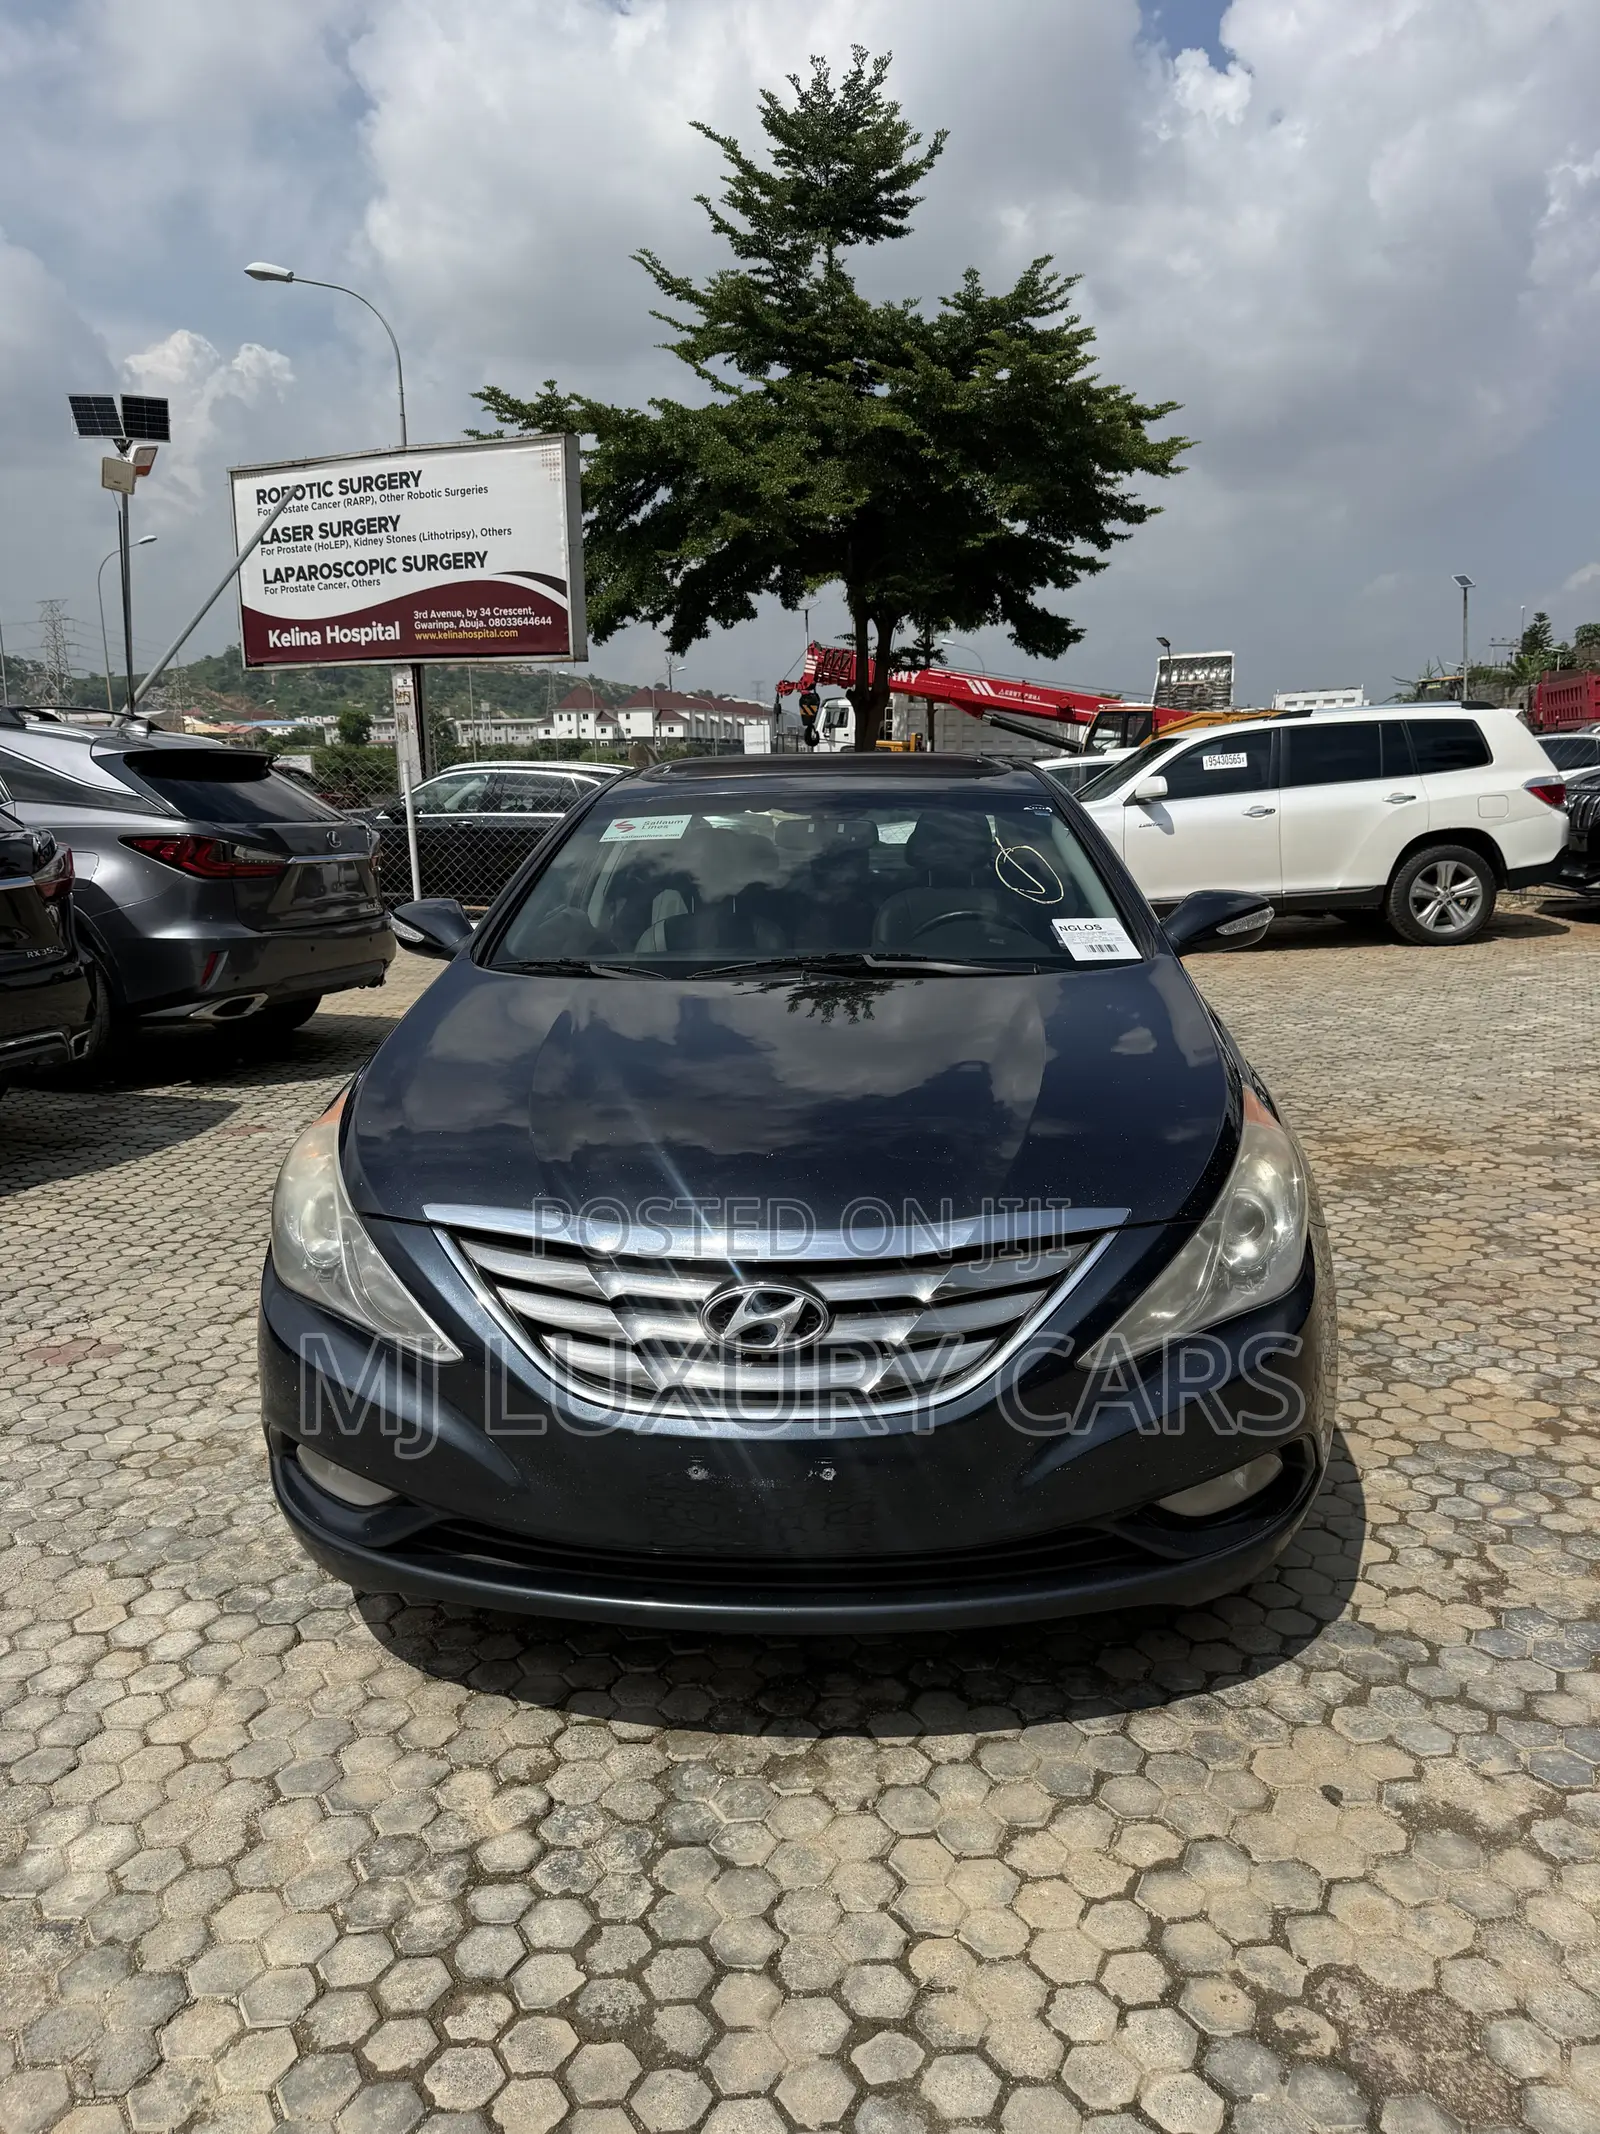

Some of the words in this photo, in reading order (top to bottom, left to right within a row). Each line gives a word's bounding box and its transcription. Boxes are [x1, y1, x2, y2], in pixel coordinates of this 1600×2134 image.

[338, 470, 422, 496] SURGERY
[257, 507, 272, 516] For
[274, 503, 309, 514] ostate
[311, 500, 341, 511] Cancer
[343, 495, 377, 508] (RARP),
[379, 492, 405, 503] Other
[407, 487, 442, 500] Robotic
[444, 484, 489, 498] Surgeries
[318, 514, 401, 539] SURGERY
[260, 546, 275, 556] For
[277, 544, 312, 555] Prostate
[314, 540, 352, 552] (HoLEP),
[353, 536, 384, 547] Kidney
[386, 534, 417, 544] Stones
[419, 528, 478, 543] (Lithotripsy),
[480, 527, 512, 537] Others
[262, 557, 398, 585] LAPAROSCOPIC
[402, 550, 488, 573] SURGERY
[264, 586, 278, 595] For
[280, 583, 315, 594] Prostate
[317, 580, 350, 591] Cancer,
[351, 577, 381, 588] Others
[413, 610, 428, 619] 3rd
[430, 609, 465, 619] Avenue,
[466, 608, 478, 618] by
[479, 607, 491, 616] 34
[493, 605, 535, 616] Crescent,
[414, 620, 457, 630] Gwarinpa,
[458, 619, 487, 629] Abuja.
[488, 616, 552, 627] 08033644644
[268, 626, 321, 648] Kelina
[325, 620, 401, 646] Hospital
[415, 628, 519, 640] www.kelinahospital.com
[1058, 924, 1102, 932] NGLOS
